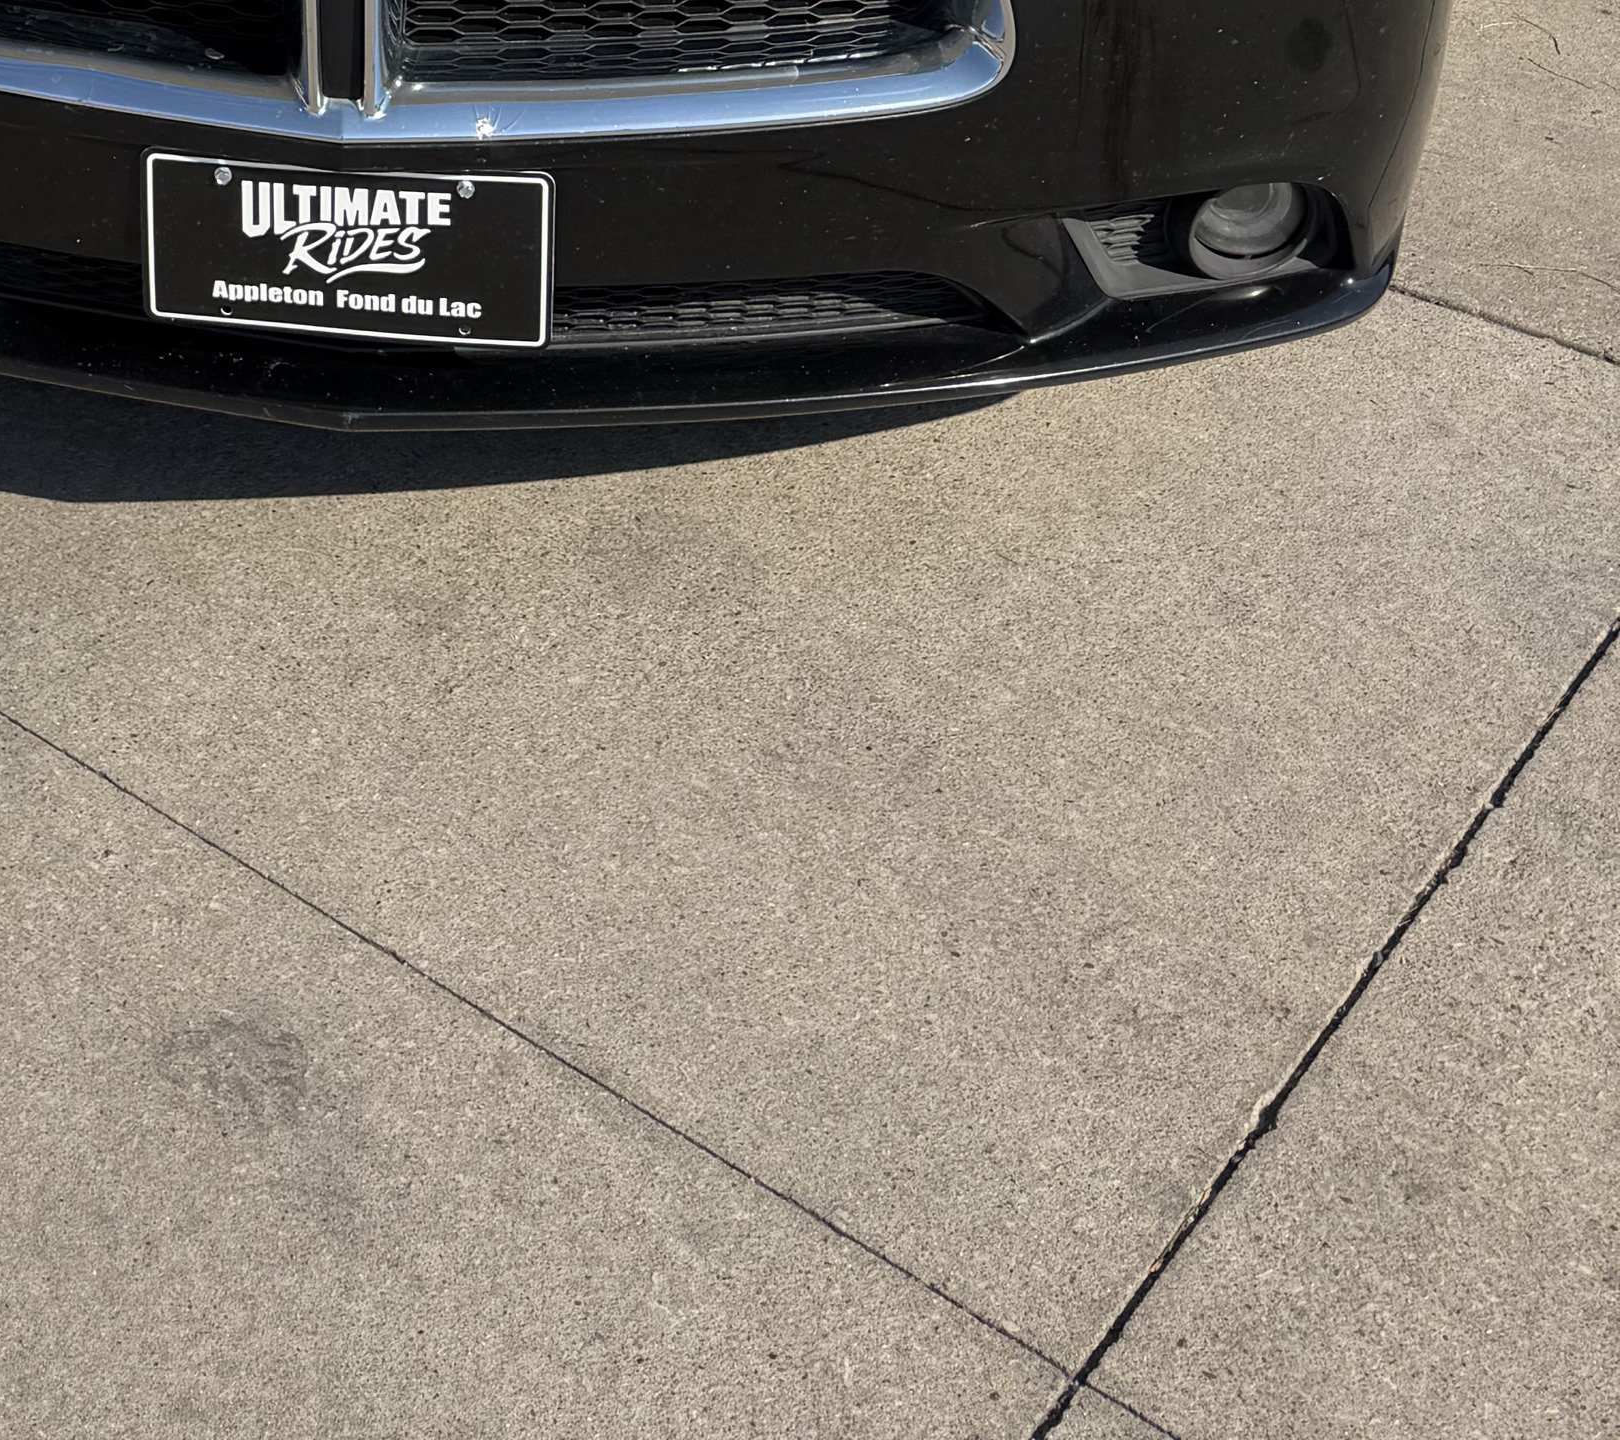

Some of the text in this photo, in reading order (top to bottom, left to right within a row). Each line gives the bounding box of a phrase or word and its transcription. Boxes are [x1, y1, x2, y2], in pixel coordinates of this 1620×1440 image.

[241, 180, 452, 237] ULTIMATE
[212, 280, 482, 319] Appleton Fond du Lac
